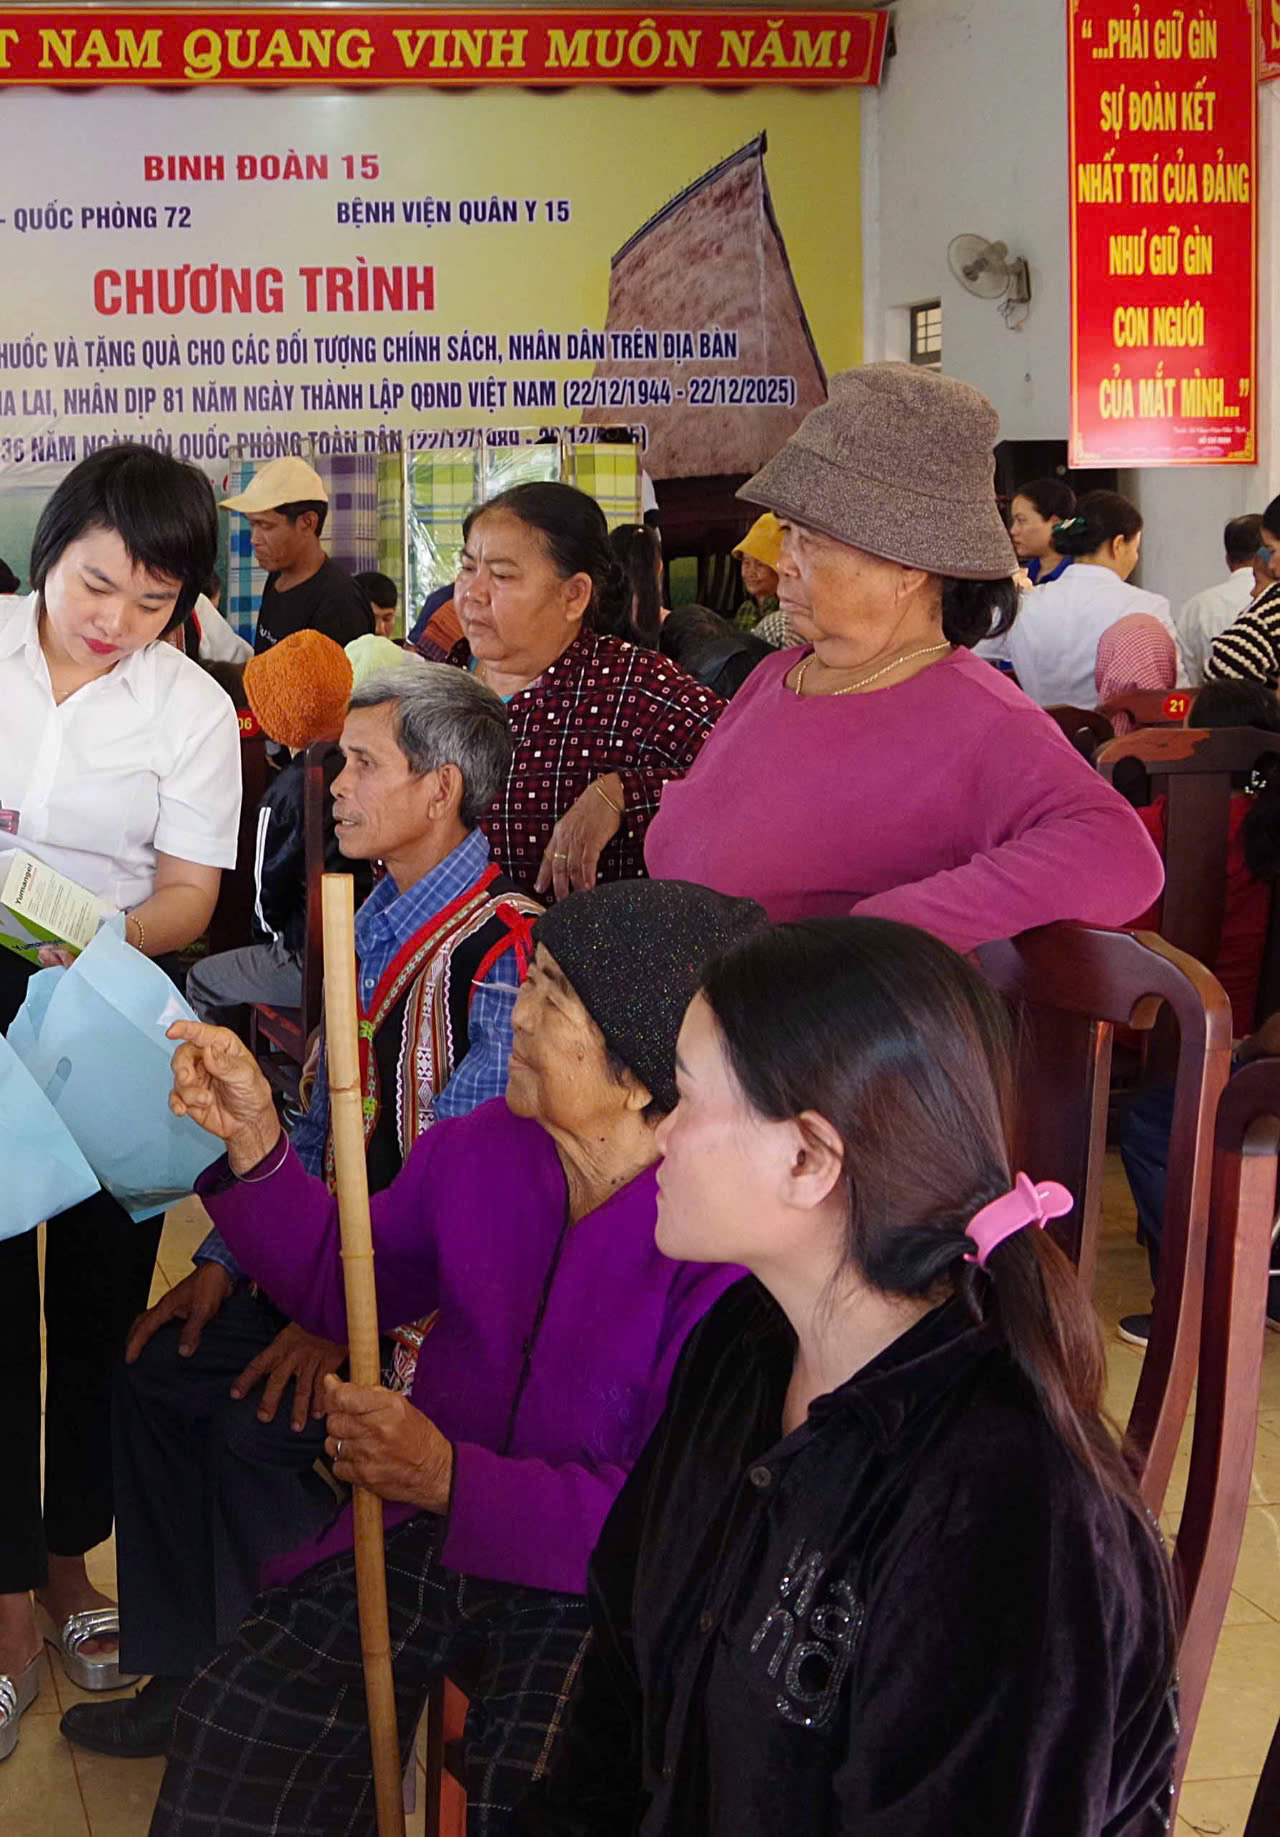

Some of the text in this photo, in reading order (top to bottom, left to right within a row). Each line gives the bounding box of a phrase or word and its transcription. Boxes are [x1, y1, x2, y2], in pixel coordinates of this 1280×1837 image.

[39, 30, 162, 68] NAM
[183, 29, 375, 79] QUANG
[393, 30, 528, 68] VINH
[546, 19, 700, 68] MUÔN
[718, 19, 852, 67] NĂM!
[1154, 10, 1184, 59] GIỮ
[1189, 10, 1217, 59] GÌN
[1100, 76, 1216, 140] SỰ ĐOÀN KẾT
[144, 147, 380, 182] BINH ĐOÀN 15
[1078, 147, 1250, 204] NHẤT TRÍ CỦA ĐẢNG
[13, 198, 74, 232] QUỐC
[81, 200, 158, 230] PHÒNG
[165, 207, 192, 229] 72
[337, 195, 570, 229] BỆNH VIỆN QUÂN Y 15
[1109, 225, 1213, 275] NHƯ GIỮ GÌN
[94, 256, 435, 316] CHƯƠNG TRÌNH
[54, 336, 79, 367] VÀ
[85, 335, 136, 373] TẶNG
[142, 336, 181, 368] QUÀ
[188, 341, 226, 366] CHO
[232, 334, 270, 366] CÁC
[276, 328, 308, 366] ĐỐI
[314, 336, 376, 371] TƯỢNG
[383, 331, 442, 364] CHÍNH
[447, 331, 502, 366] SÁCH,
[509, 329, 560, 362] NHÂN
[567, 328, 604, 361] DÂN
[612, 327, 657, 360] TRÊN
[663, 333, 694, 366] ĐỊA
[700, 326, 737, 359] BÀN
[1113, 306, 1149, 347] CON
[22, 389, 58, 419] LAI,
[63, 380, 118, 416] NHÂN
[125, 386, 157, 423] DỊP
[163, 387, 185, 413] 81
[192, 379, 237, 414] NĂM
[243, 380, 295, 412] NGÀY
[300, 377, 364, 412] THÀNH
[369, 378, 404, 416] LẬP
[411, 381, 460, 411] QĐND
[468, 375, 507, 415] VIỆT
[513, 380, 556, 408] NAM
[563, 376, 672, 411] (22/12/1944
[688, 375, 797, 407] 22/12/2025)
[1099, 363, 1134, 419] CỦA
[1139, 360, 1176, 418] MẮT
[31, 430, 76, 463] NĂM
[179, 423, 230, 464] QUỐC
[364, 423, 401, 454] DÂN
[1169, 699, 1185, 713] 21
[15, 864, 33, 905] Yumangel
